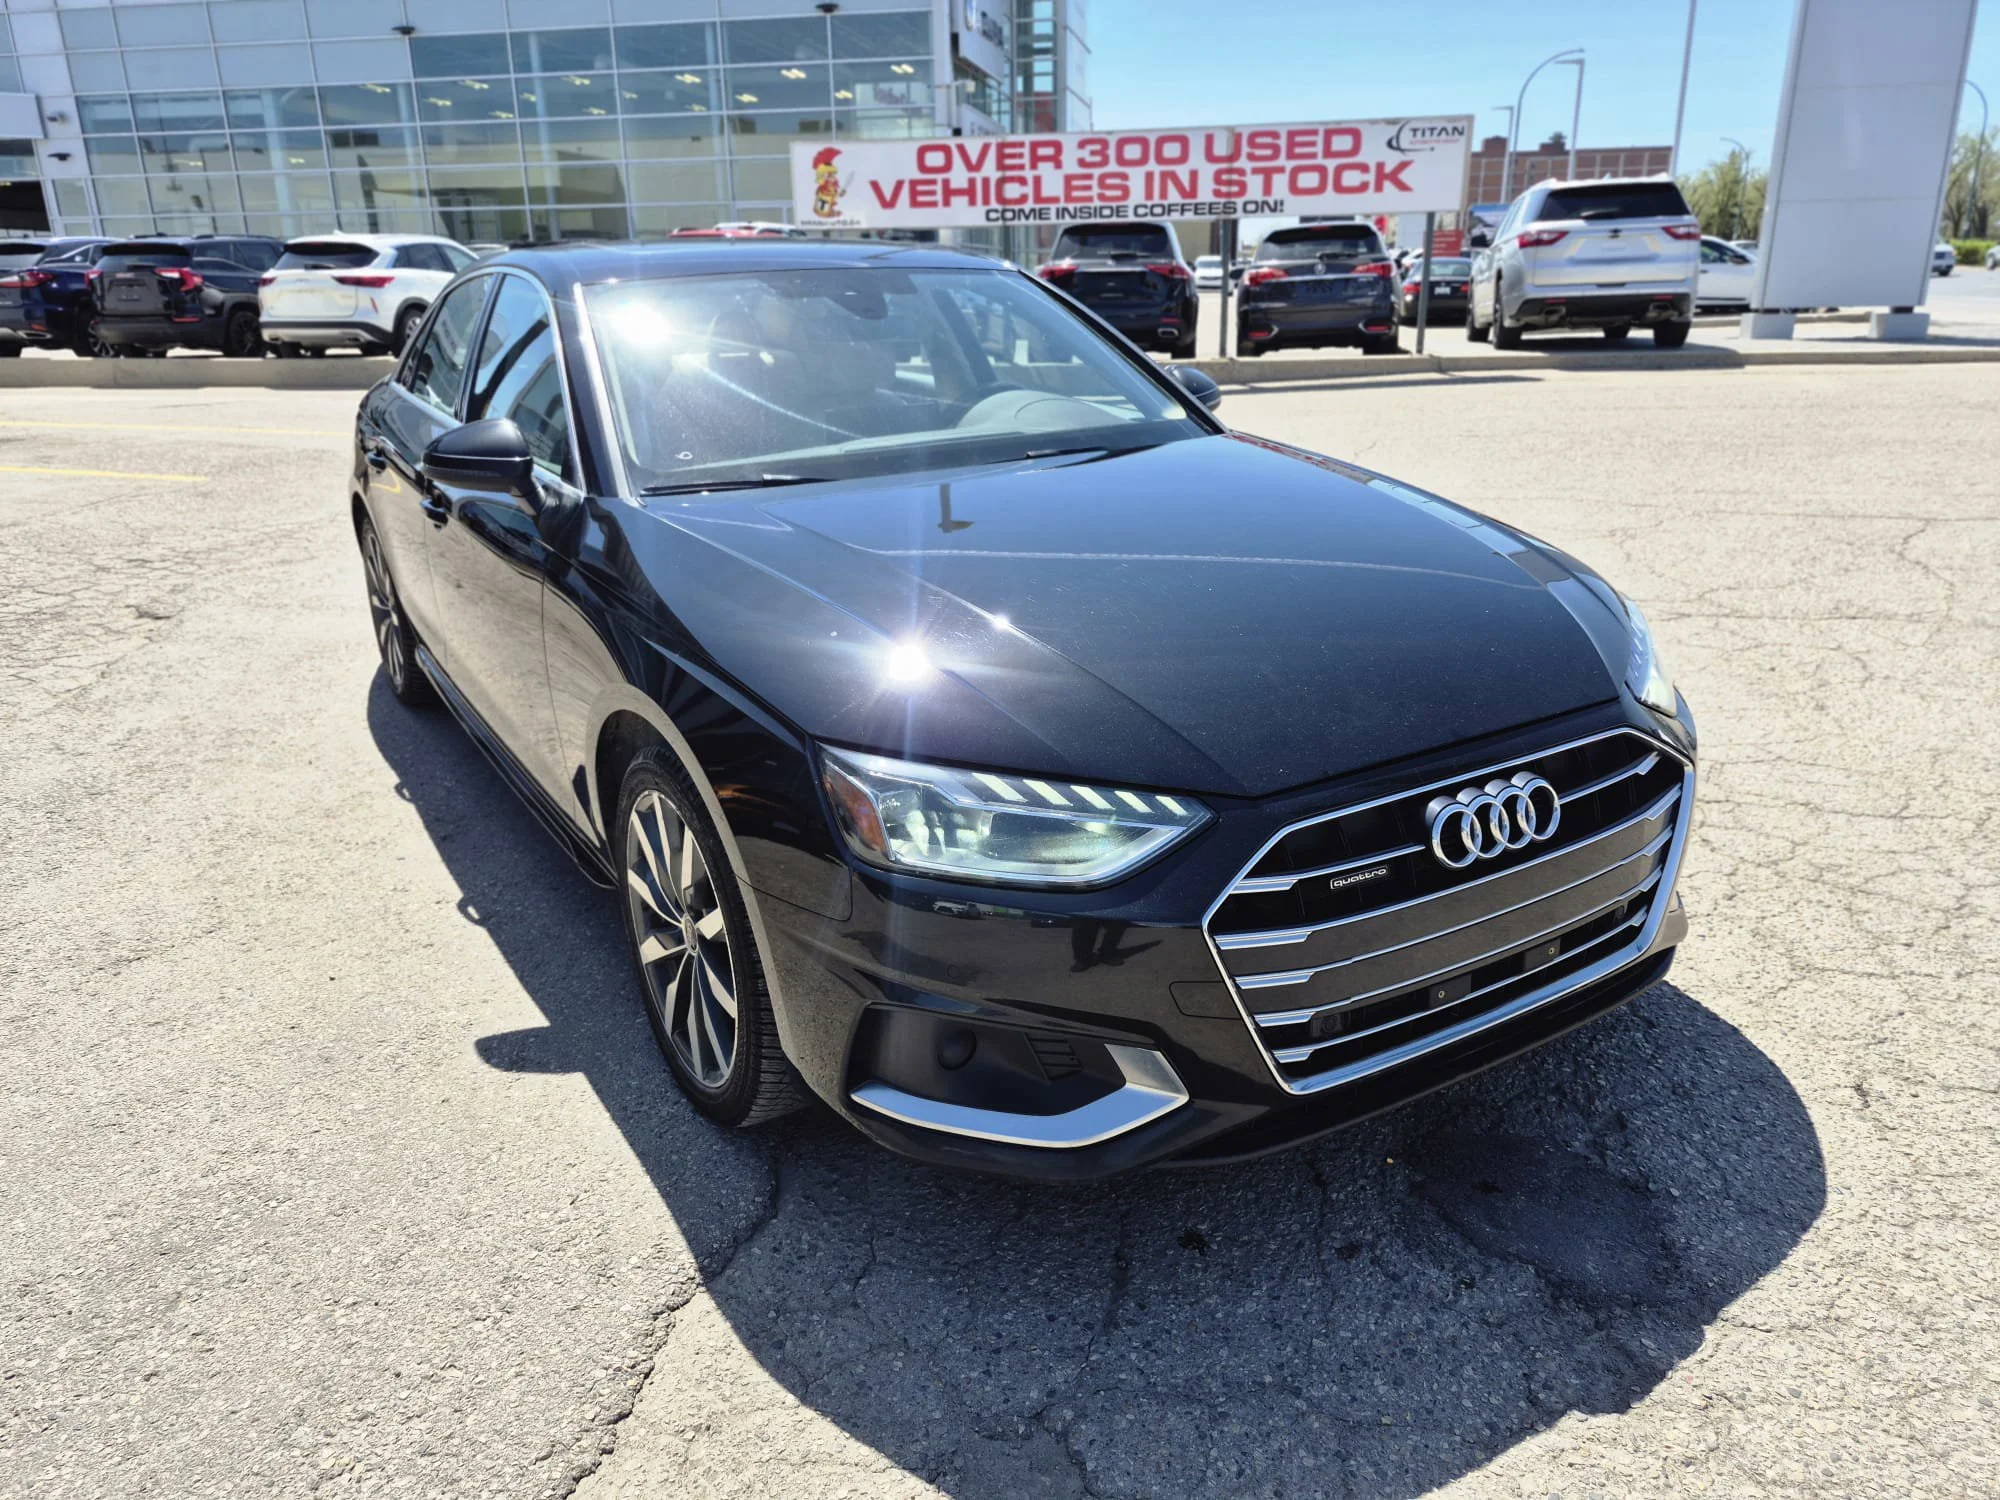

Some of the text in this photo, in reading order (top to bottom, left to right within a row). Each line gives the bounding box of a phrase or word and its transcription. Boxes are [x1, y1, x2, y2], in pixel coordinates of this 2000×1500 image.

[1410, 126, 1465, 138] TITAN
[916, 127, 1363, 175] OVER 300 USED
[869, 160, 1415, 210] VEHICLES IN STOCK
[985, 200, 1285, 223] COME INSIDE COFFEES ON!
[1333, 868, 1387, 887] quattro
